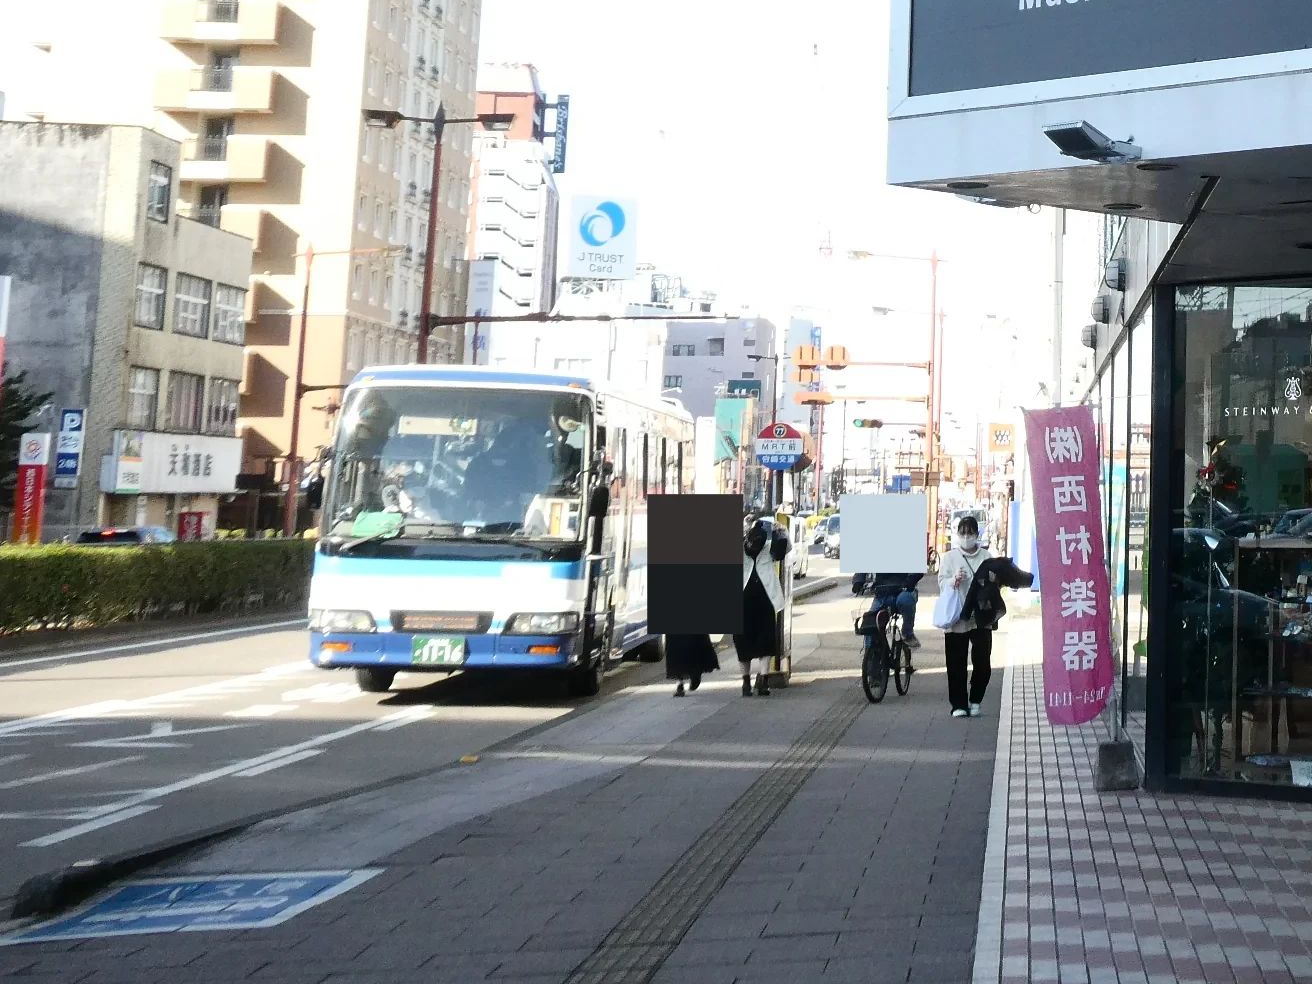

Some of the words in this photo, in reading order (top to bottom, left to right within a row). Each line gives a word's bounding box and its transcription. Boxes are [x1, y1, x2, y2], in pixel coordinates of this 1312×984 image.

[587, 252, 625, 264] TRUST
[589, 263, 613, 273] Card
[1224, 405, 1300, 417] STEINWAY
[63, 412, 81, 431] P
